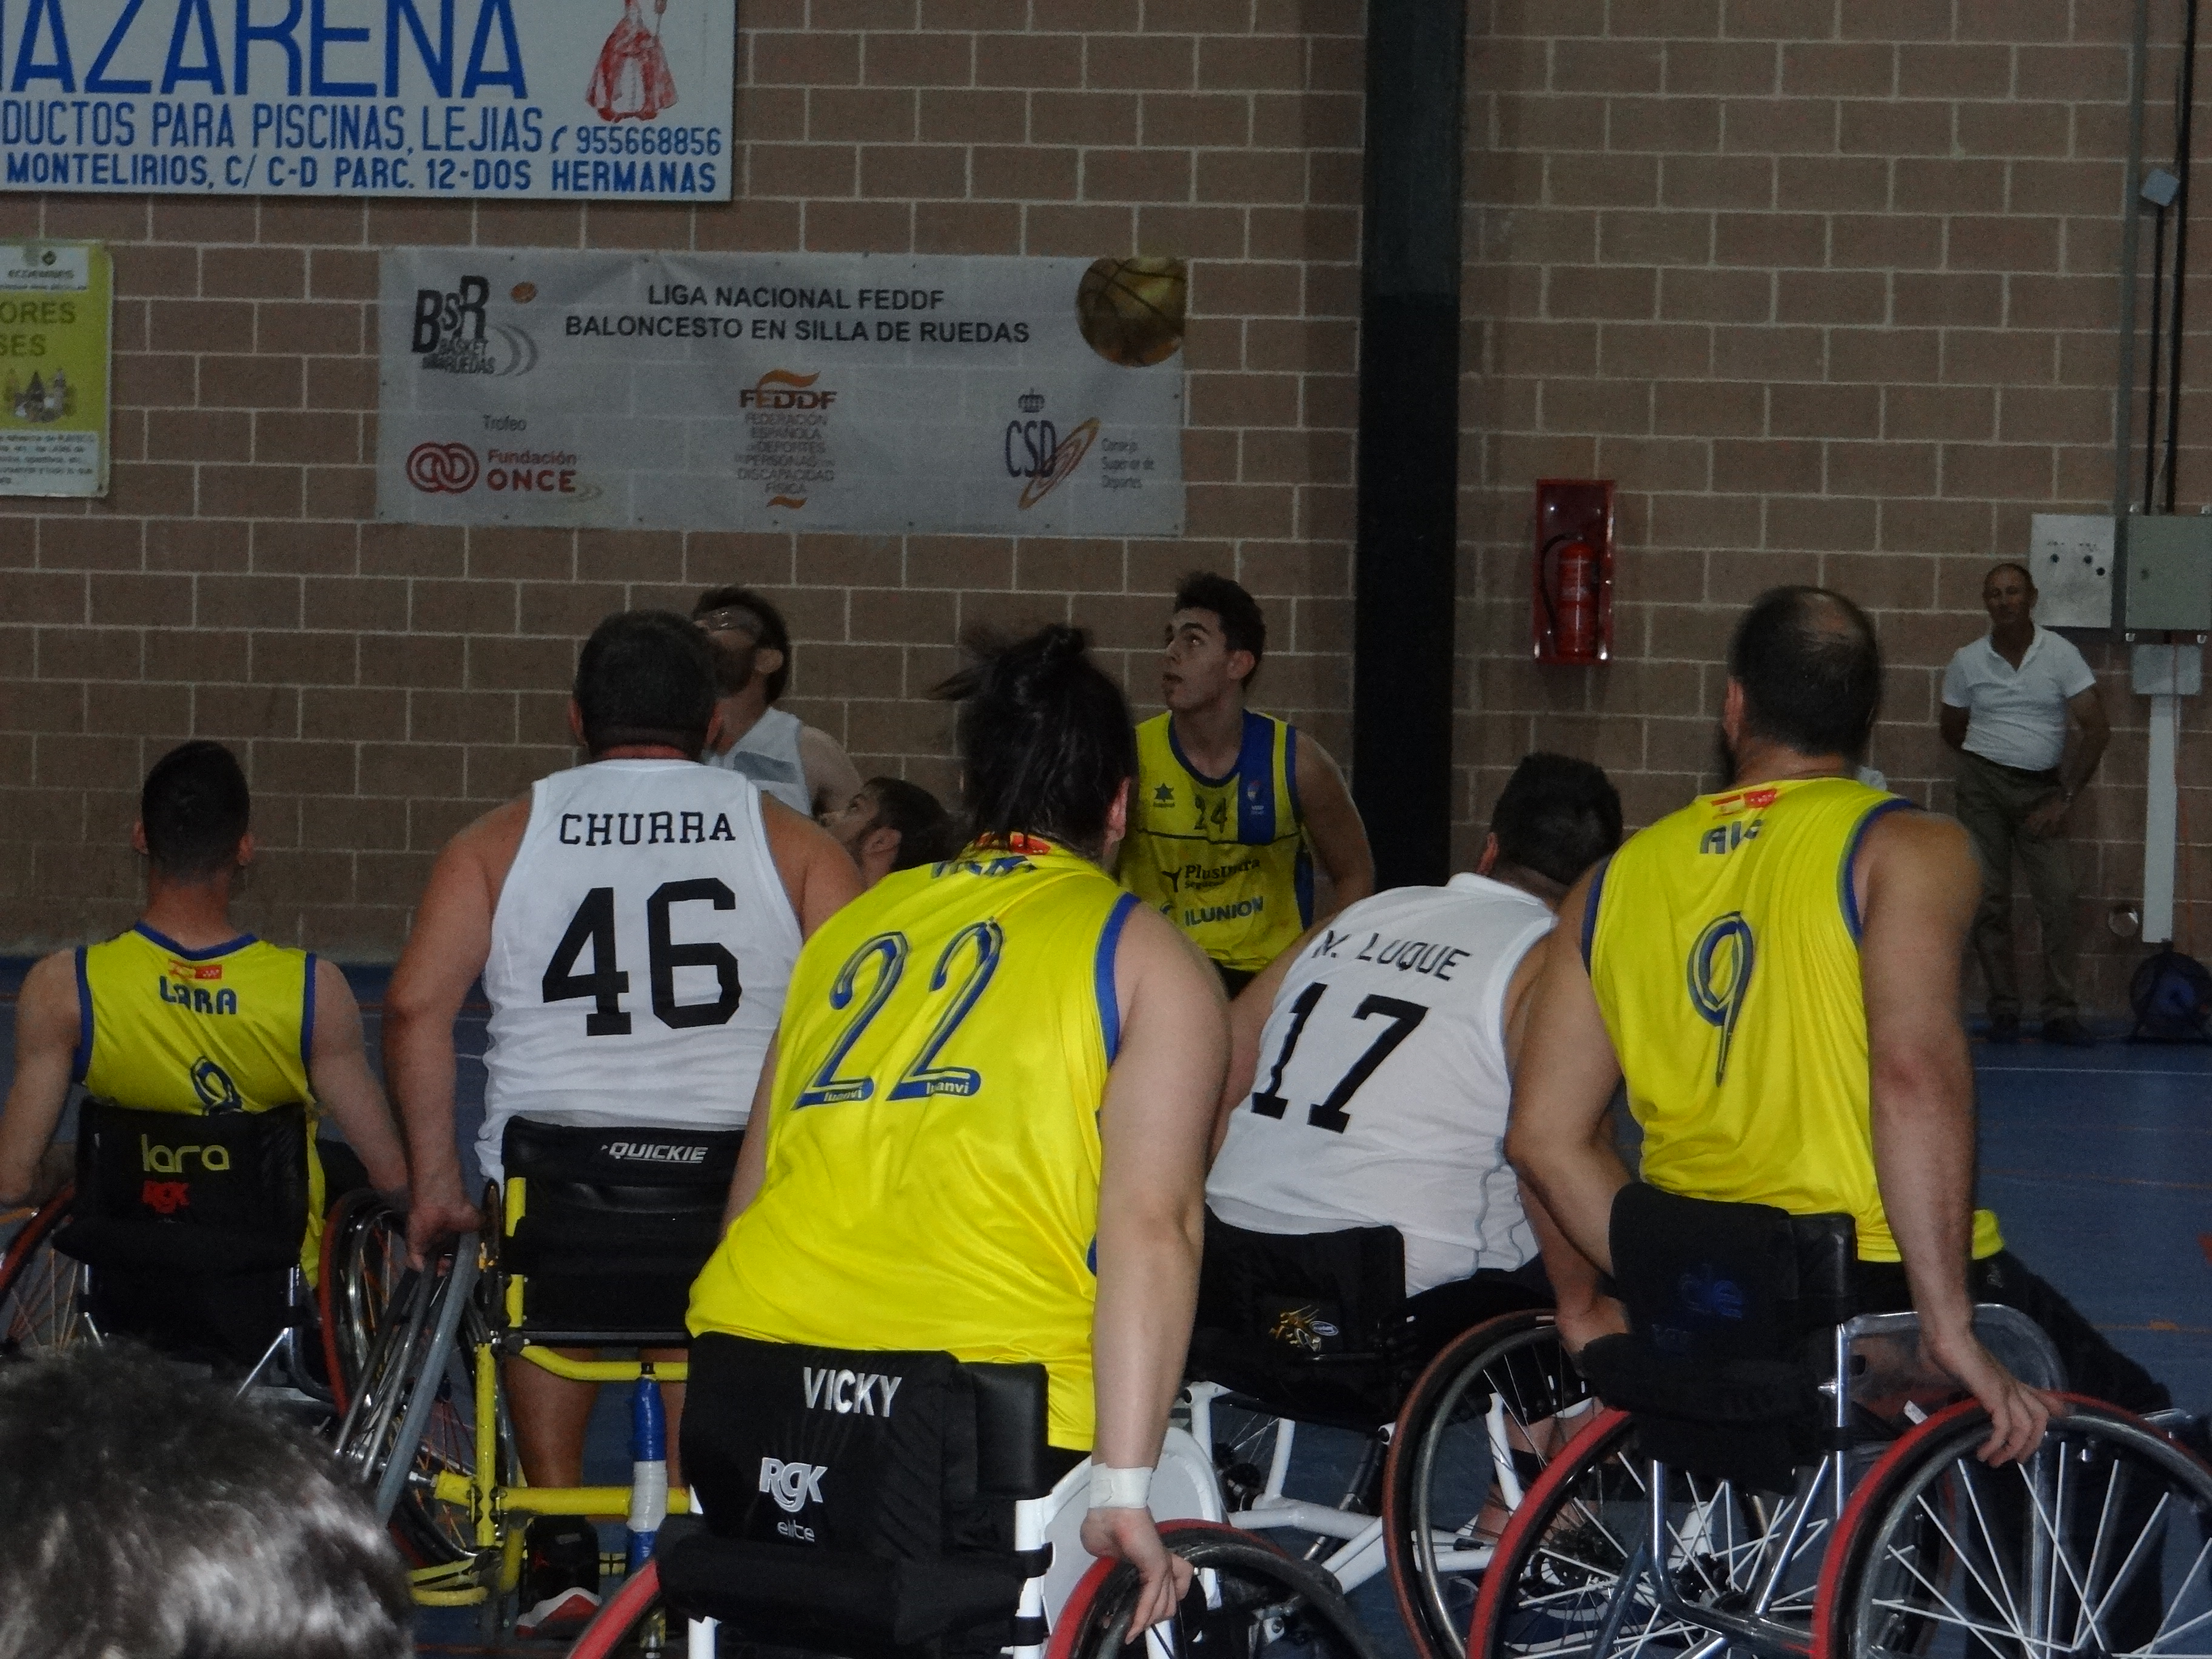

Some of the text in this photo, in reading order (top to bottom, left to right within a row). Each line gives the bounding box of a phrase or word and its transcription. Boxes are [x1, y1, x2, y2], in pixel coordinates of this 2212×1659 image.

[0, 0, 528, 99] AZARENA
[2, 99, 135, 146] DUCTOS
[152, 101, 235, 147] PARA
[421, 105, 543, 153] LEJIAS
[575, 125, 722, 156] 955668856
[334, 156, 415, 189] PARC.
[551, 159, 716, 193] HERMANAS
[648, 284, 945, 310] LIGA NACIONAL FEDDF
[565, 315, 1030, 344] BALONCESTO EN SILLA DE RUEDAS
[739, 388, 838, 410] FEDDF
[483, 414, 528, 432] Trofeo
[487, 448, 577, 466] Fundación
[1005, 419, 1057, 478] CSD
[487, 468, 577, 493] ONCE
[559, 811, 736, 846] CHURRA
[1185, 896, 1264, 927] ILUNION
[542, 877, 743, 1036] 46
[1356, 932, 1473, 981] LUQUE
[159, 975, 238, 1015] LARA
[789, 916, 1007, 1111] 22
[1686, 910, 1754, 1088] 9
[1250, 981, 1430, 1134] 17
[141, 1133, 230, 1173] lara
[609, 1142, 708, 1162] QUICKIE
[803, 1367, 902, 1418] VICKY
